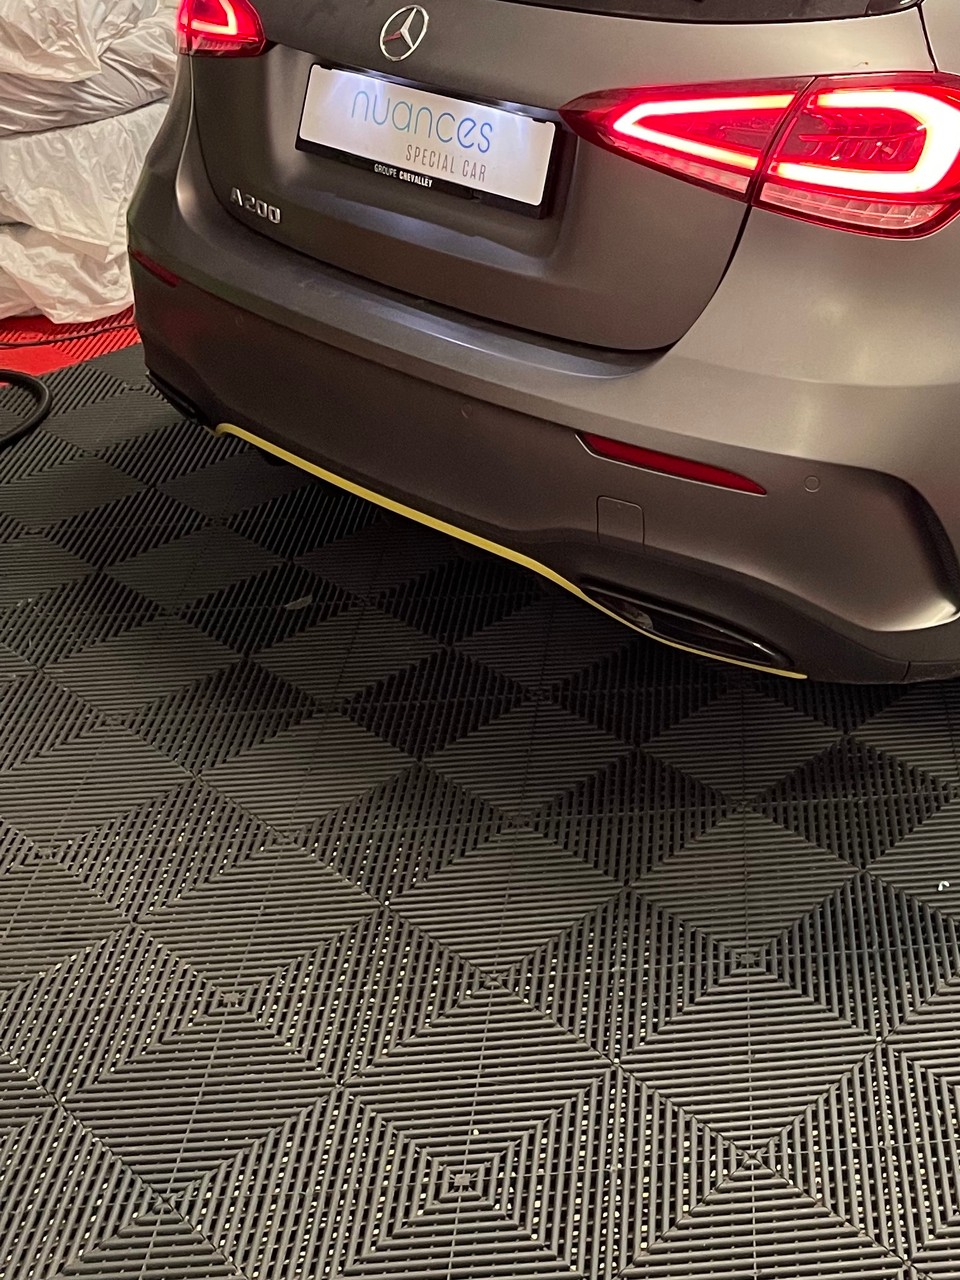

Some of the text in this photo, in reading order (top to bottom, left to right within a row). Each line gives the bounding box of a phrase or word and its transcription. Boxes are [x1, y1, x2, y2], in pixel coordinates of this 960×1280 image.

[351, 90, 493, 153] nuances
[373, 163, 433, 188] GROUPE CHEVALLEY
[406, 144, 487, 183] SPECIAL CAR
